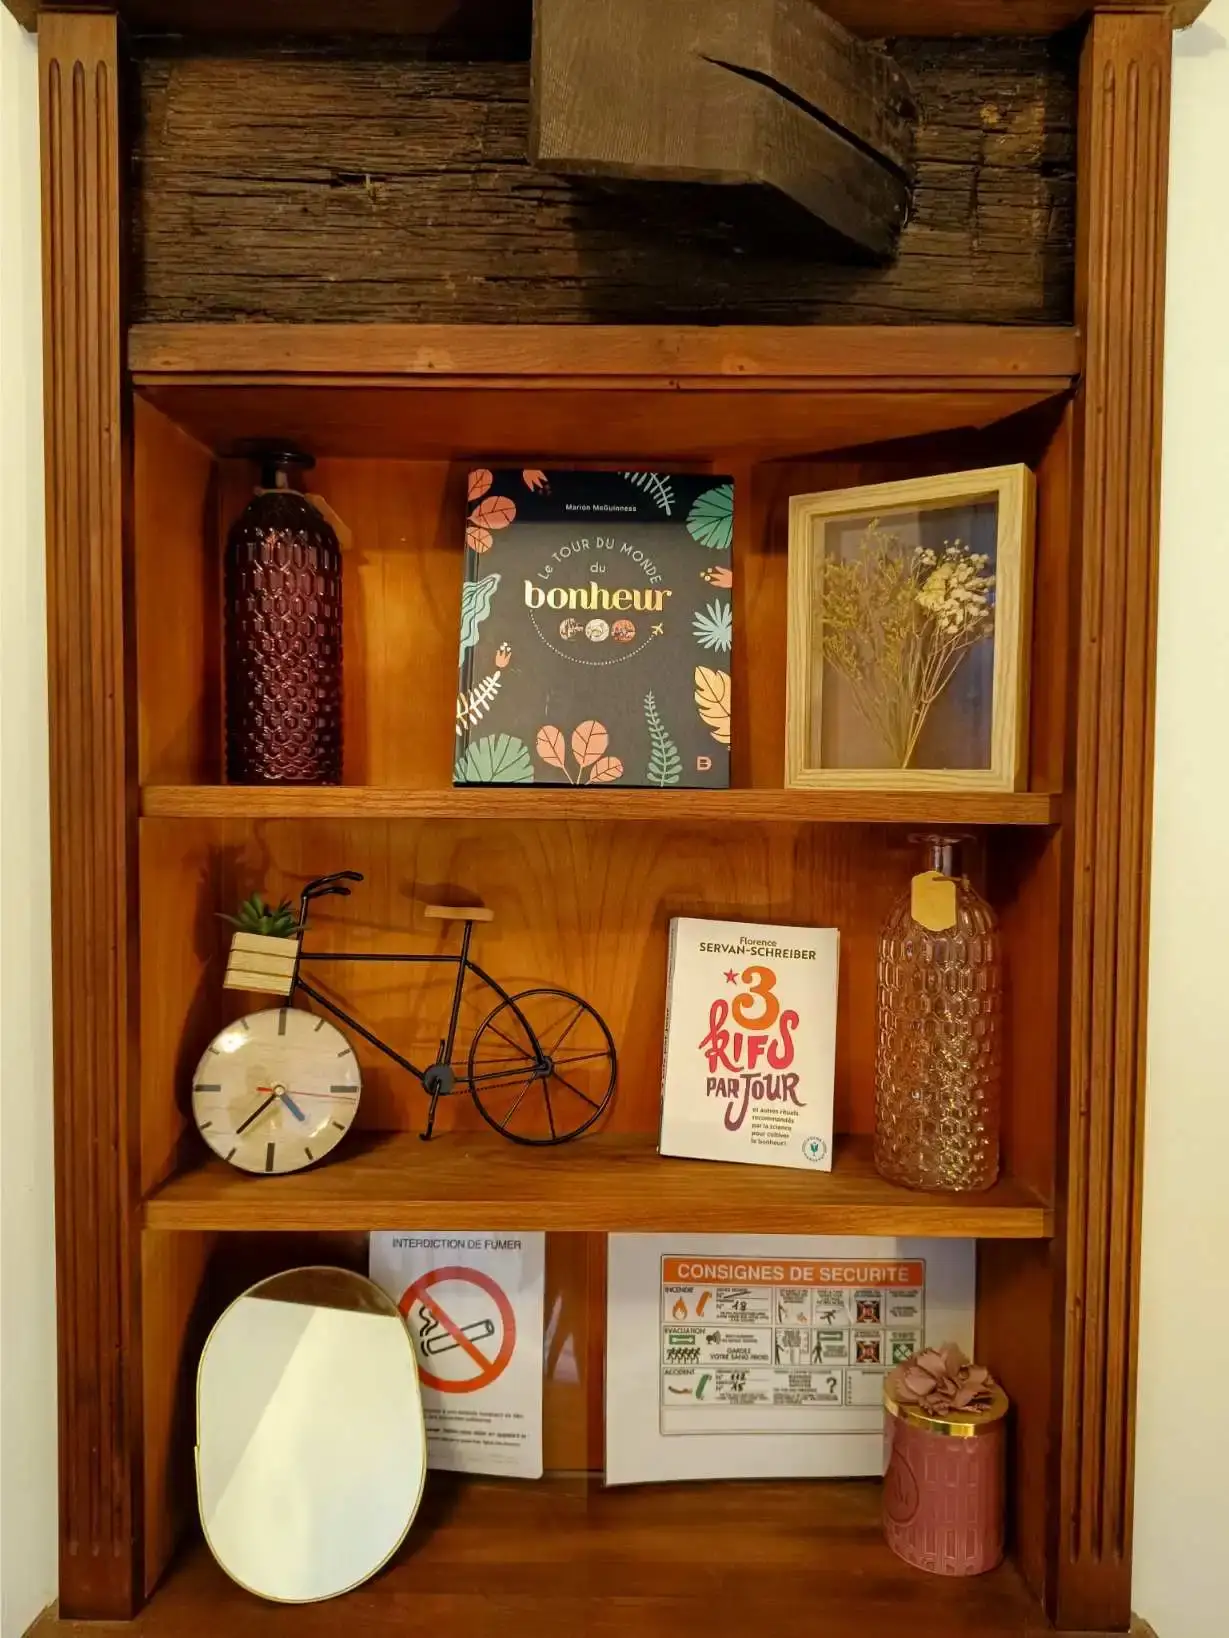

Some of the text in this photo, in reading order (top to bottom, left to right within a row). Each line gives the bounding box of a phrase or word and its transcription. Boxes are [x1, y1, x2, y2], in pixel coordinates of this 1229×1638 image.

[565, 503, 638, 513] Marion McGuinness
[551, 538, 590, 563] TOUR
[596, 536, 615, 550] DU
[620, 541, 662, 585] MONDE
[590, 562, 606, 574] du
[524, 580, 673, 612] bonheur
[739, 936, 778, 947] Florence
[699, 942, 816, 960] SERVAN-SCHREIBER
[732, 965, 780, 1031] 3
[706, 1076, 739, 1099] PAR
[392, 1238, 522, 1250] INTERDICTION DE FUMER
[677, 1263, 784, 1281] CONSIGNES
[789, 1266, 813, 1281] DE
